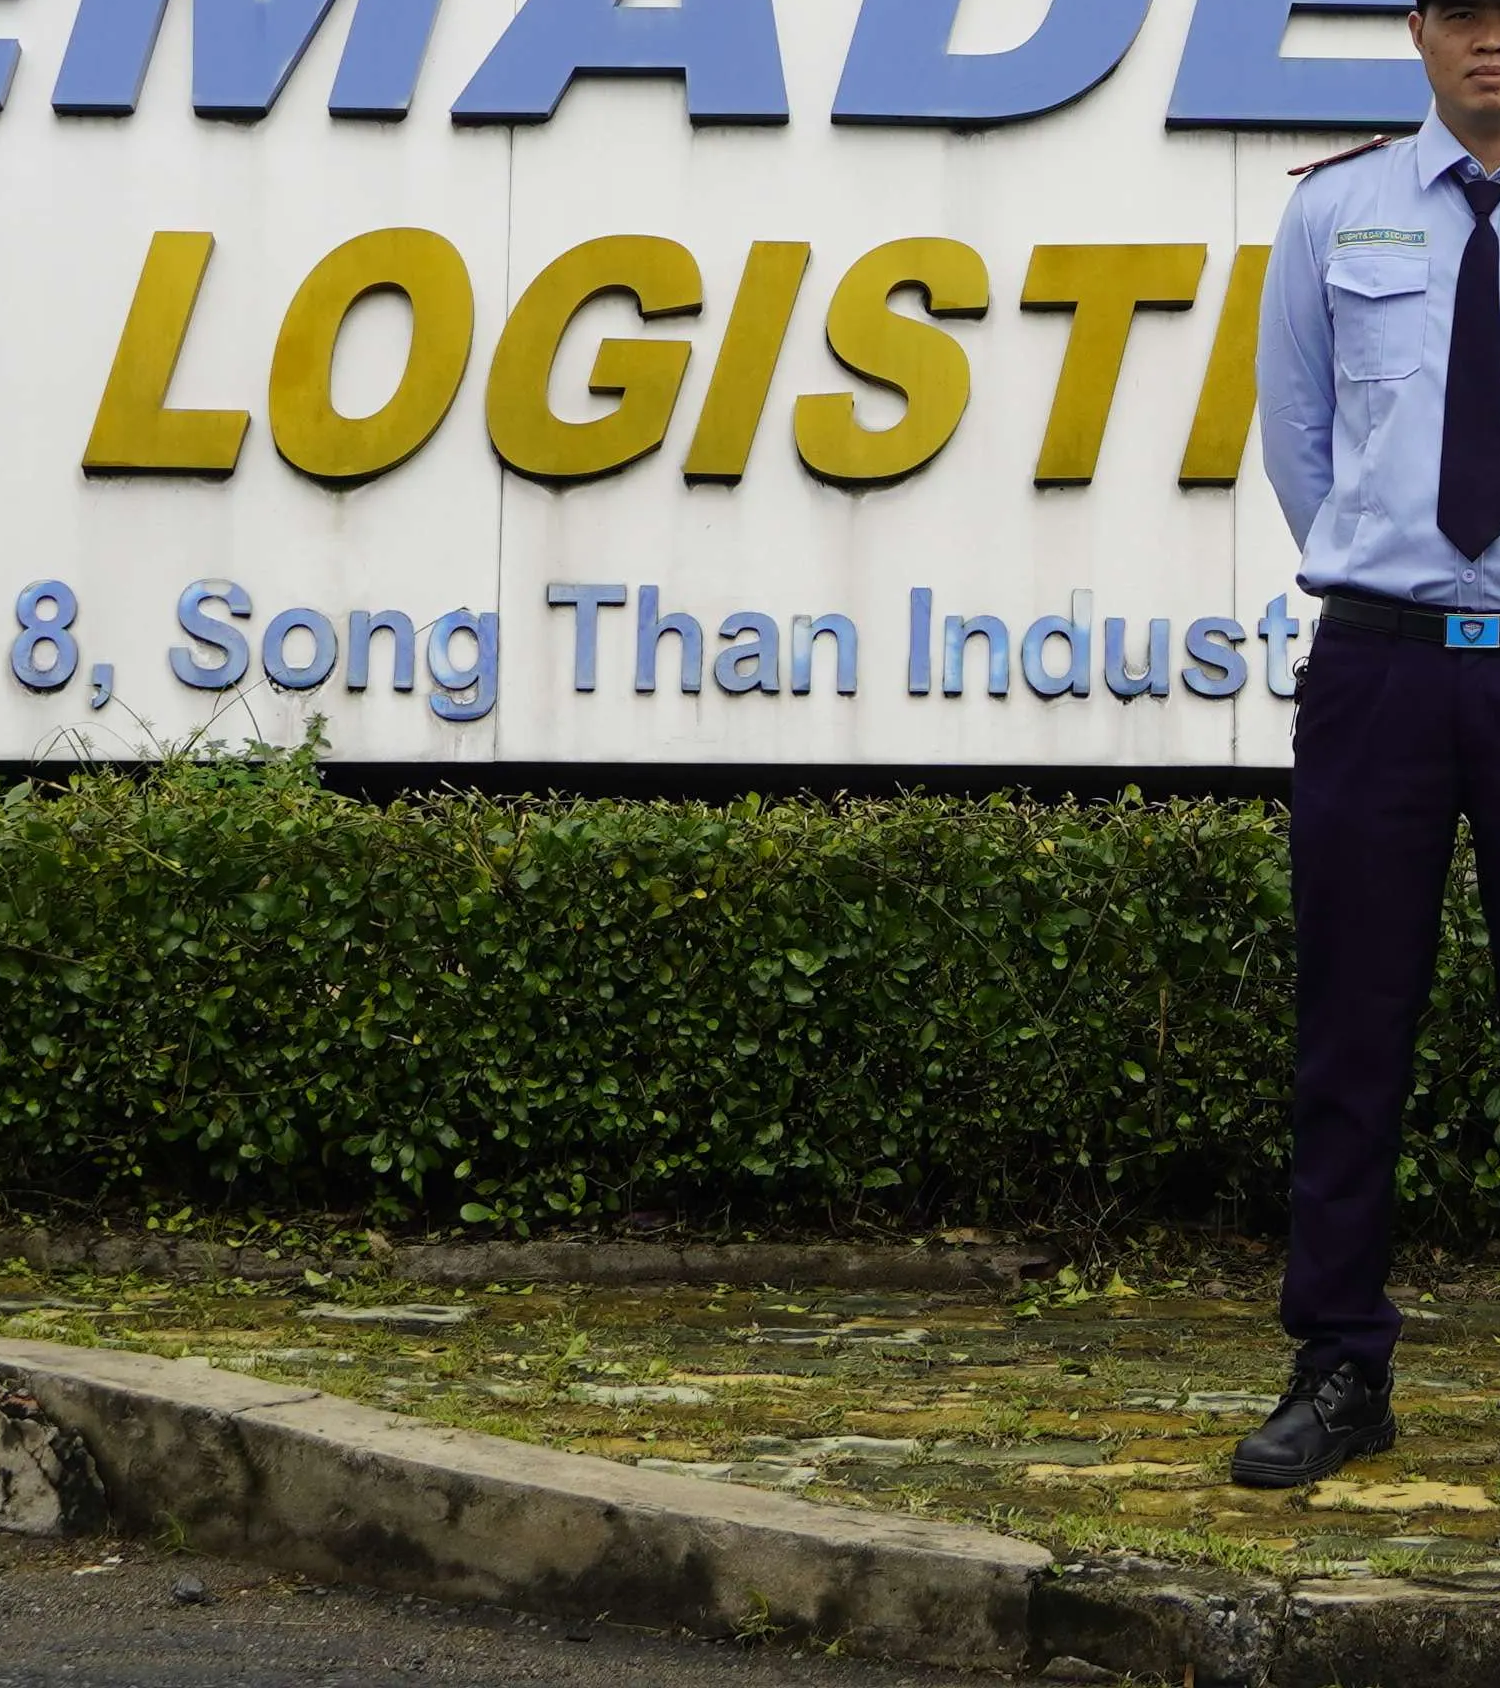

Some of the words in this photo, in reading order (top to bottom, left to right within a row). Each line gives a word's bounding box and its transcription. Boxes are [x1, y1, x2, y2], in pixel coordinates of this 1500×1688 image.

[81, 226, 1274, 492] LOGISTI
[11, 578, 115, 709] 8,
[168, 577, 501, 722] Song
[546, 583, 859, 696] Than
[907, 587, 1302, 699] Indust
